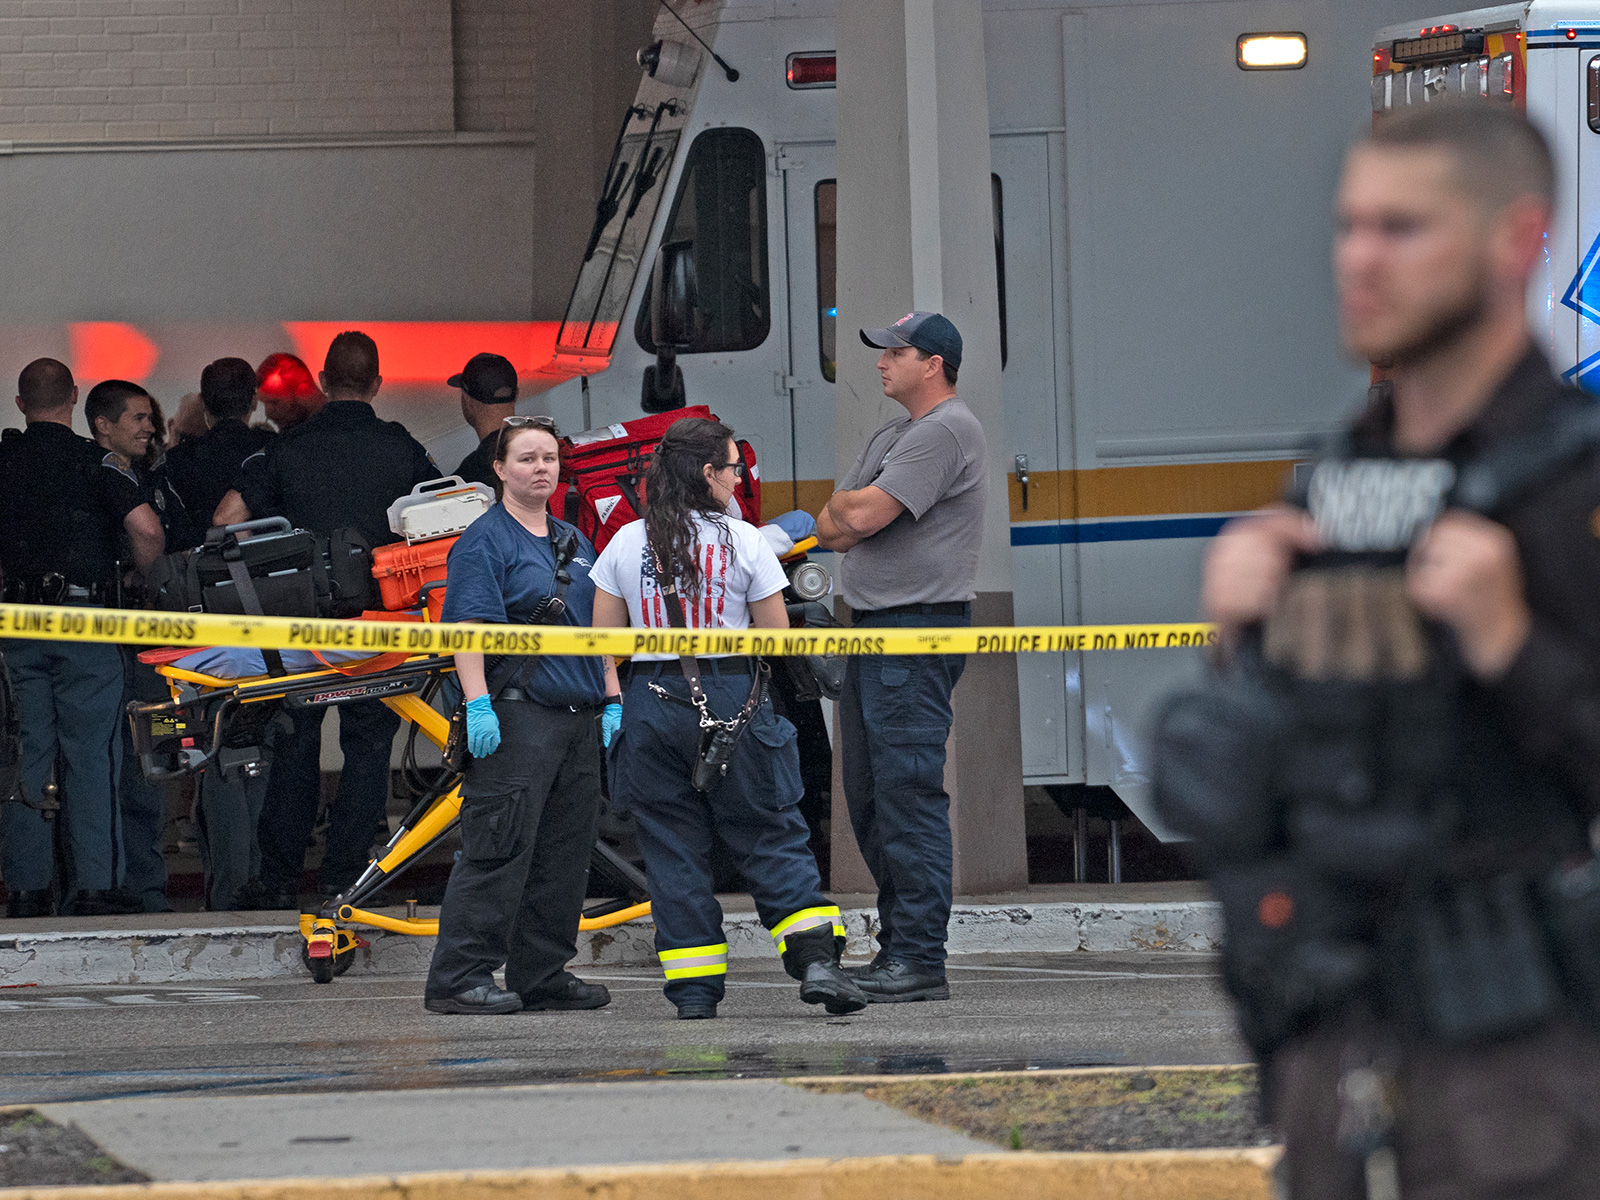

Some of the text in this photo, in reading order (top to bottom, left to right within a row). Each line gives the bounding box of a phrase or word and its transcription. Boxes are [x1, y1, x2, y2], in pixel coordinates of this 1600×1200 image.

[13, 610, 53, 632] LINE
[60, 612, 86, 634] DO
[92, 614, 128, 636] NOT
[134, 616, 196, 640] CROSS
[288, 623, 542, 651] POLICE LINE DO NOT CROSS
[633, 634, 699, 653] POLICE
[705, 636, 745, 654] LINE
[752, 637, 775, 655] DO
[782, 637, 817, 655] NOT
[824, 636, 885, 655] CROSS
[976, 634, 1040, 653] POLICE
[1047, 634, 1086, 651] LINE
[1093, 634, 1117, 650] DO
[1125, 633, 1160, 649] NOT
